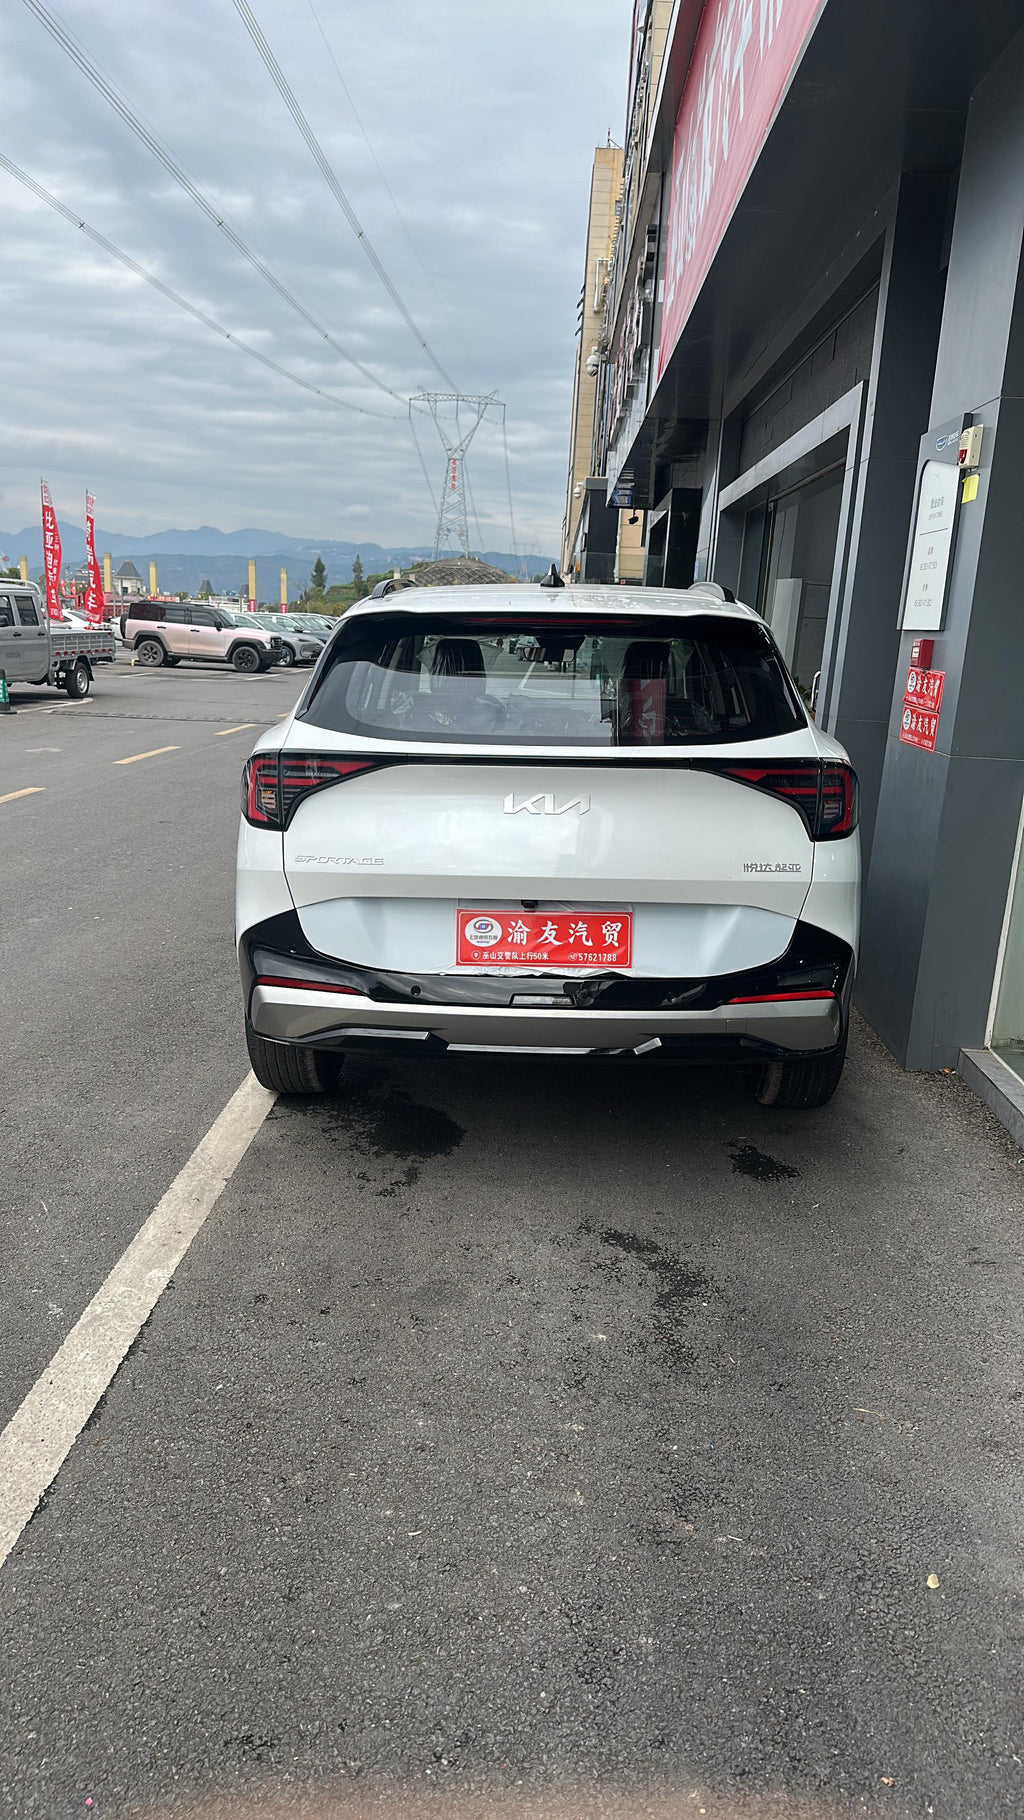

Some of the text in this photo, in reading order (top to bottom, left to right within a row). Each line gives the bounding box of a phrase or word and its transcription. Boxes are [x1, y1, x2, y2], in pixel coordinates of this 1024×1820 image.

[503, 792, 591, 815] KIA
[294, 855, 385, 866] SPORTAGE
[743, 862, 802, 873] 悦达起亚
[507, 919, 623, 948] 渝友汽贸
[482, 951, 549, 961] 巫山交警队上行50米
[578, 952, 617, 962] 57621788
